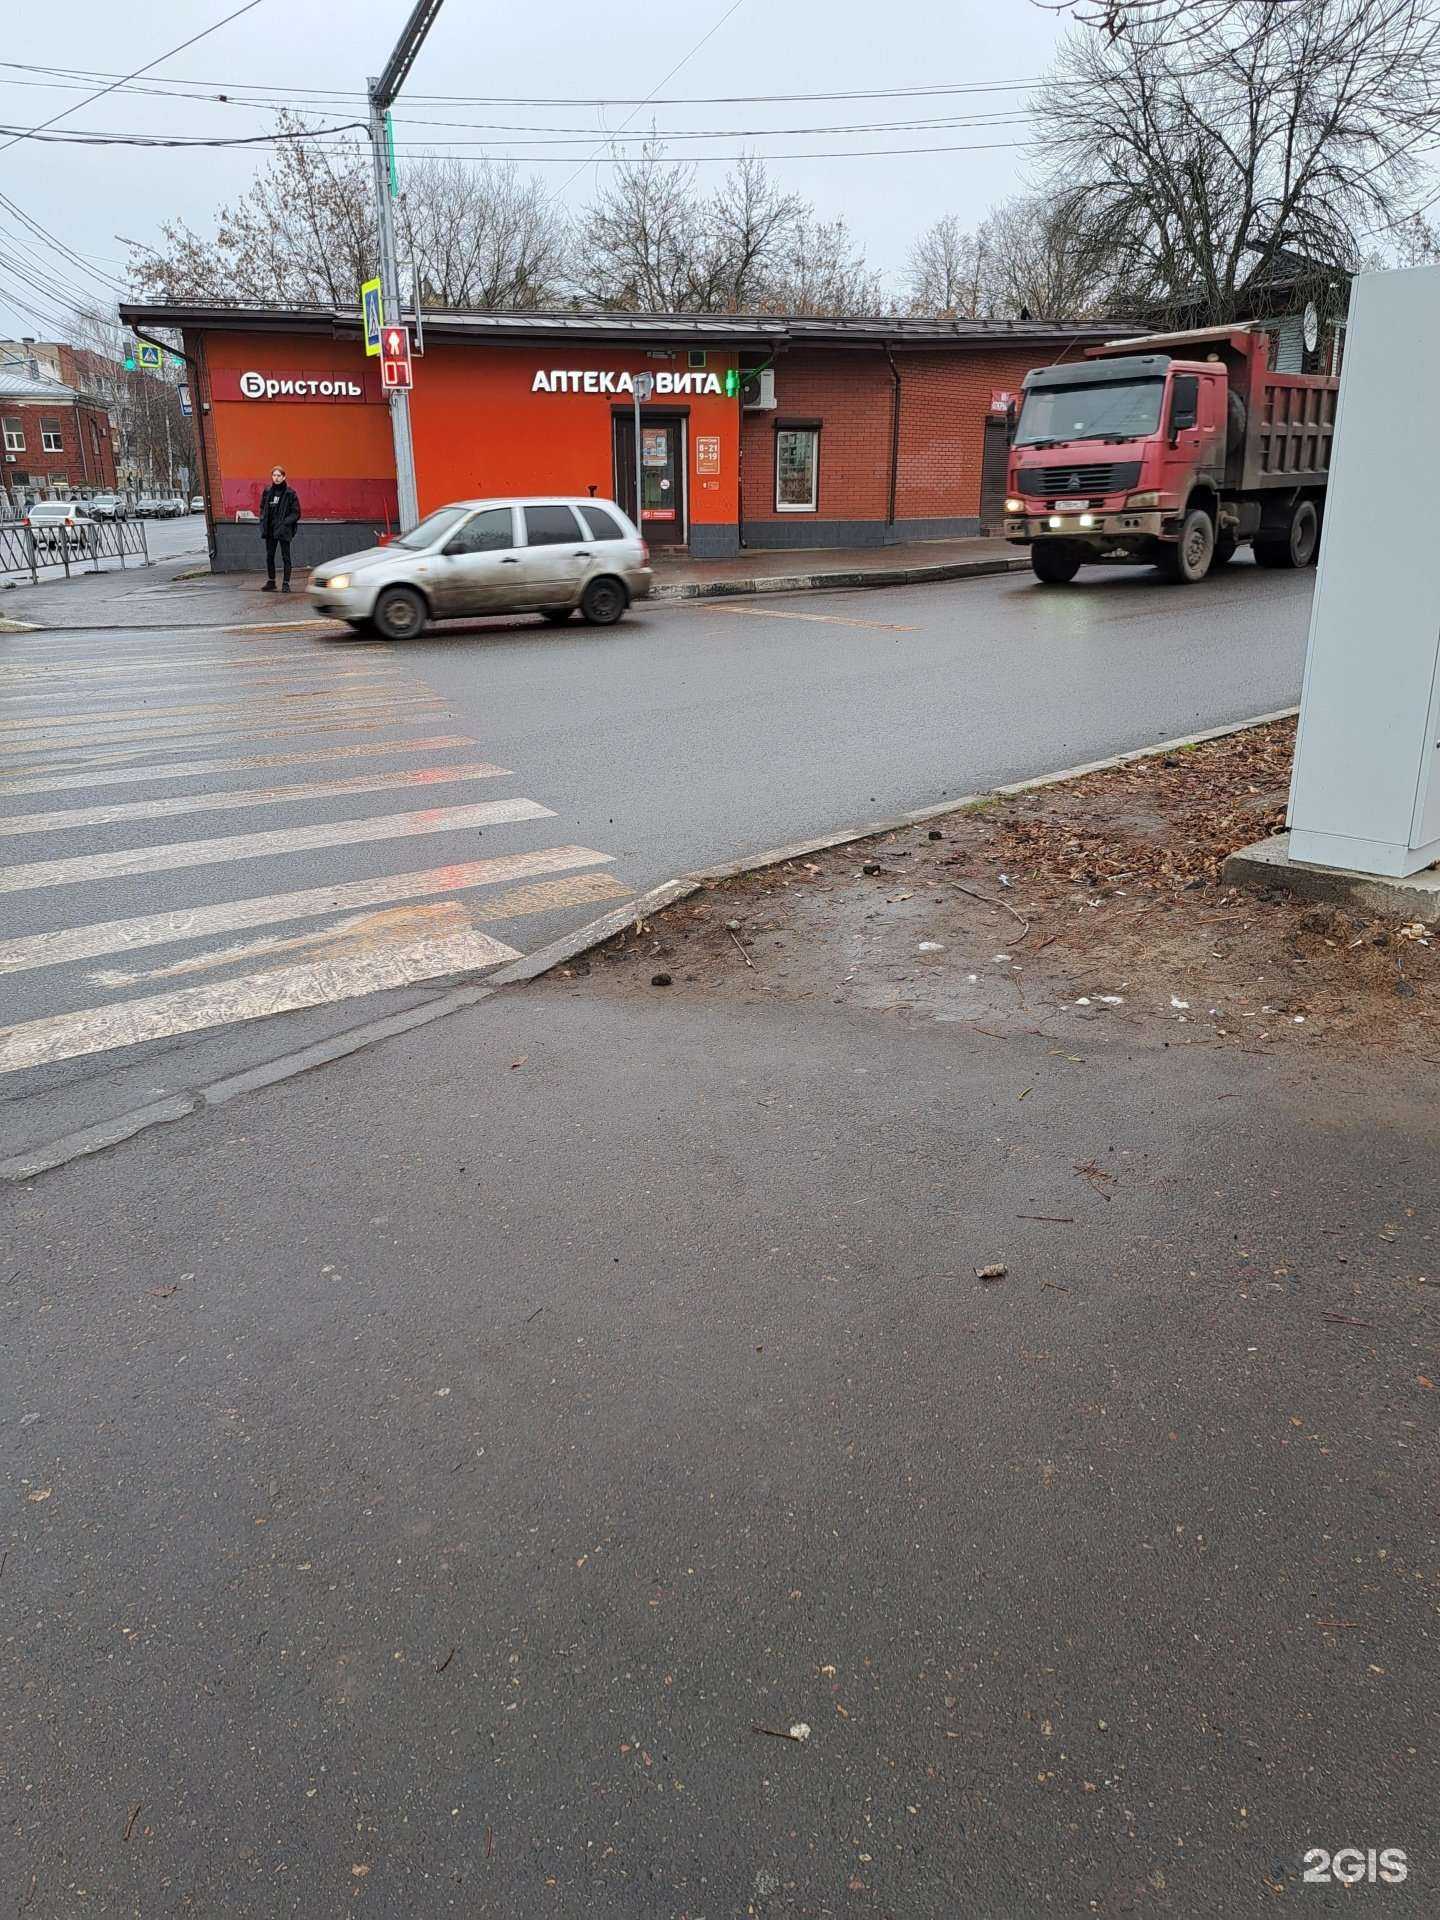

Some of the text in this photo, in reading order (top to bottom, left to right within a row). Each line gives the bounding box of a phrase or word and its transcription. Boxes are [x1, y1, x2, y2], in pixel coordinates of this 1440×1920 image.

[384, 361, 409, 384] 07
[531, 370, 722, 394] АПТЕКА ВИТА
[240, 372, 362, 398] Бристоль
